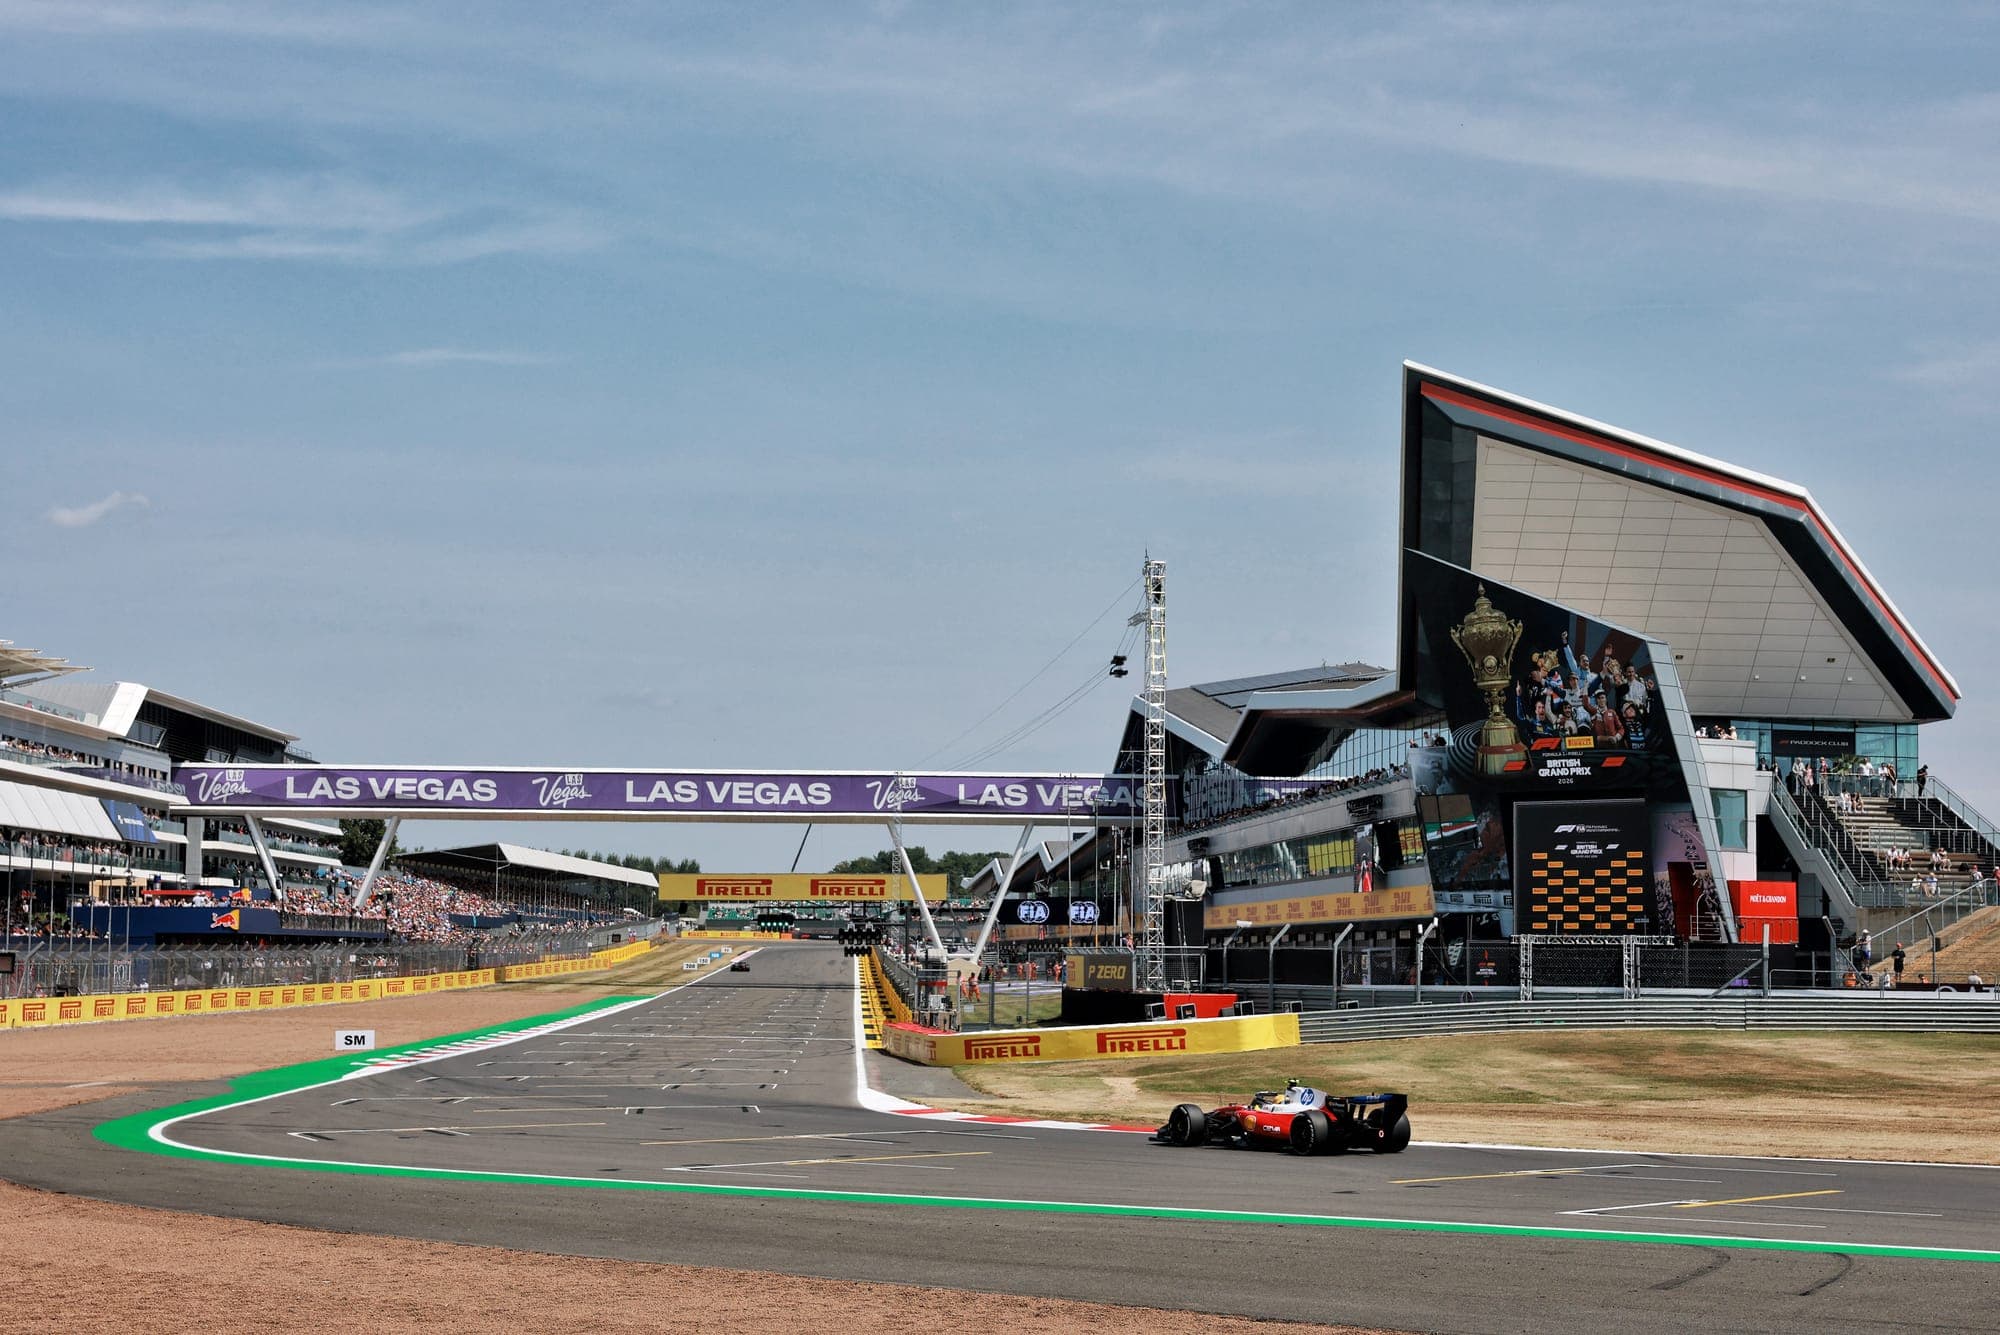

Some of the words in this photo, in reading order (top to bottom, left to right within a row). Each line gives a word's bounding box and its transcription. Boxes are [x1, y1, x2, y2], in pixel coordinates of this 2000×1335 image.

[1538, 768, 1569, 777] GRAND
[1570, 767, 1592, 776] PRIX
[1546, 759, 1581, 768] BRITISH
[226, 770, 243, 781] LAS
[566, 774, 582, 785] LAS
[192, 772, 252, 803] Vegas
[286, 777, 361, 800] LAS
[367, 778, 498, 802] VEGAS
[532, 776, 592, 808] Vegas
[625, 780, 699, 804] LAS
[705, 781, 832, 806] VEGAS
[866, 780, 926, 809] Vegas
[958, 783, 1028, 807] LAS
[696, 879, 773, 896] PIRELLI
[810, 879, 886, 896] PIRELLI
[1020, 906, 1046, 918] FIA
[1070, 906, 1095, 918] FIA
[1089, 966, 1096, 979] P
[1097, 965, 1127, 980] ZERO
[22, 1002, 46, 1022] PIRELLI
[59, 1001, 82, 1020] PIRELLI
[94, 999, 115, 1017] PIRELLI
[344, 1035, 366, 1046] SM
[964, 1035, 1041, 1060] PIRELLI
[1096, 1028, 1187, 1054] PIRELLI
[1301, 1090, 1314, 1105] hp
